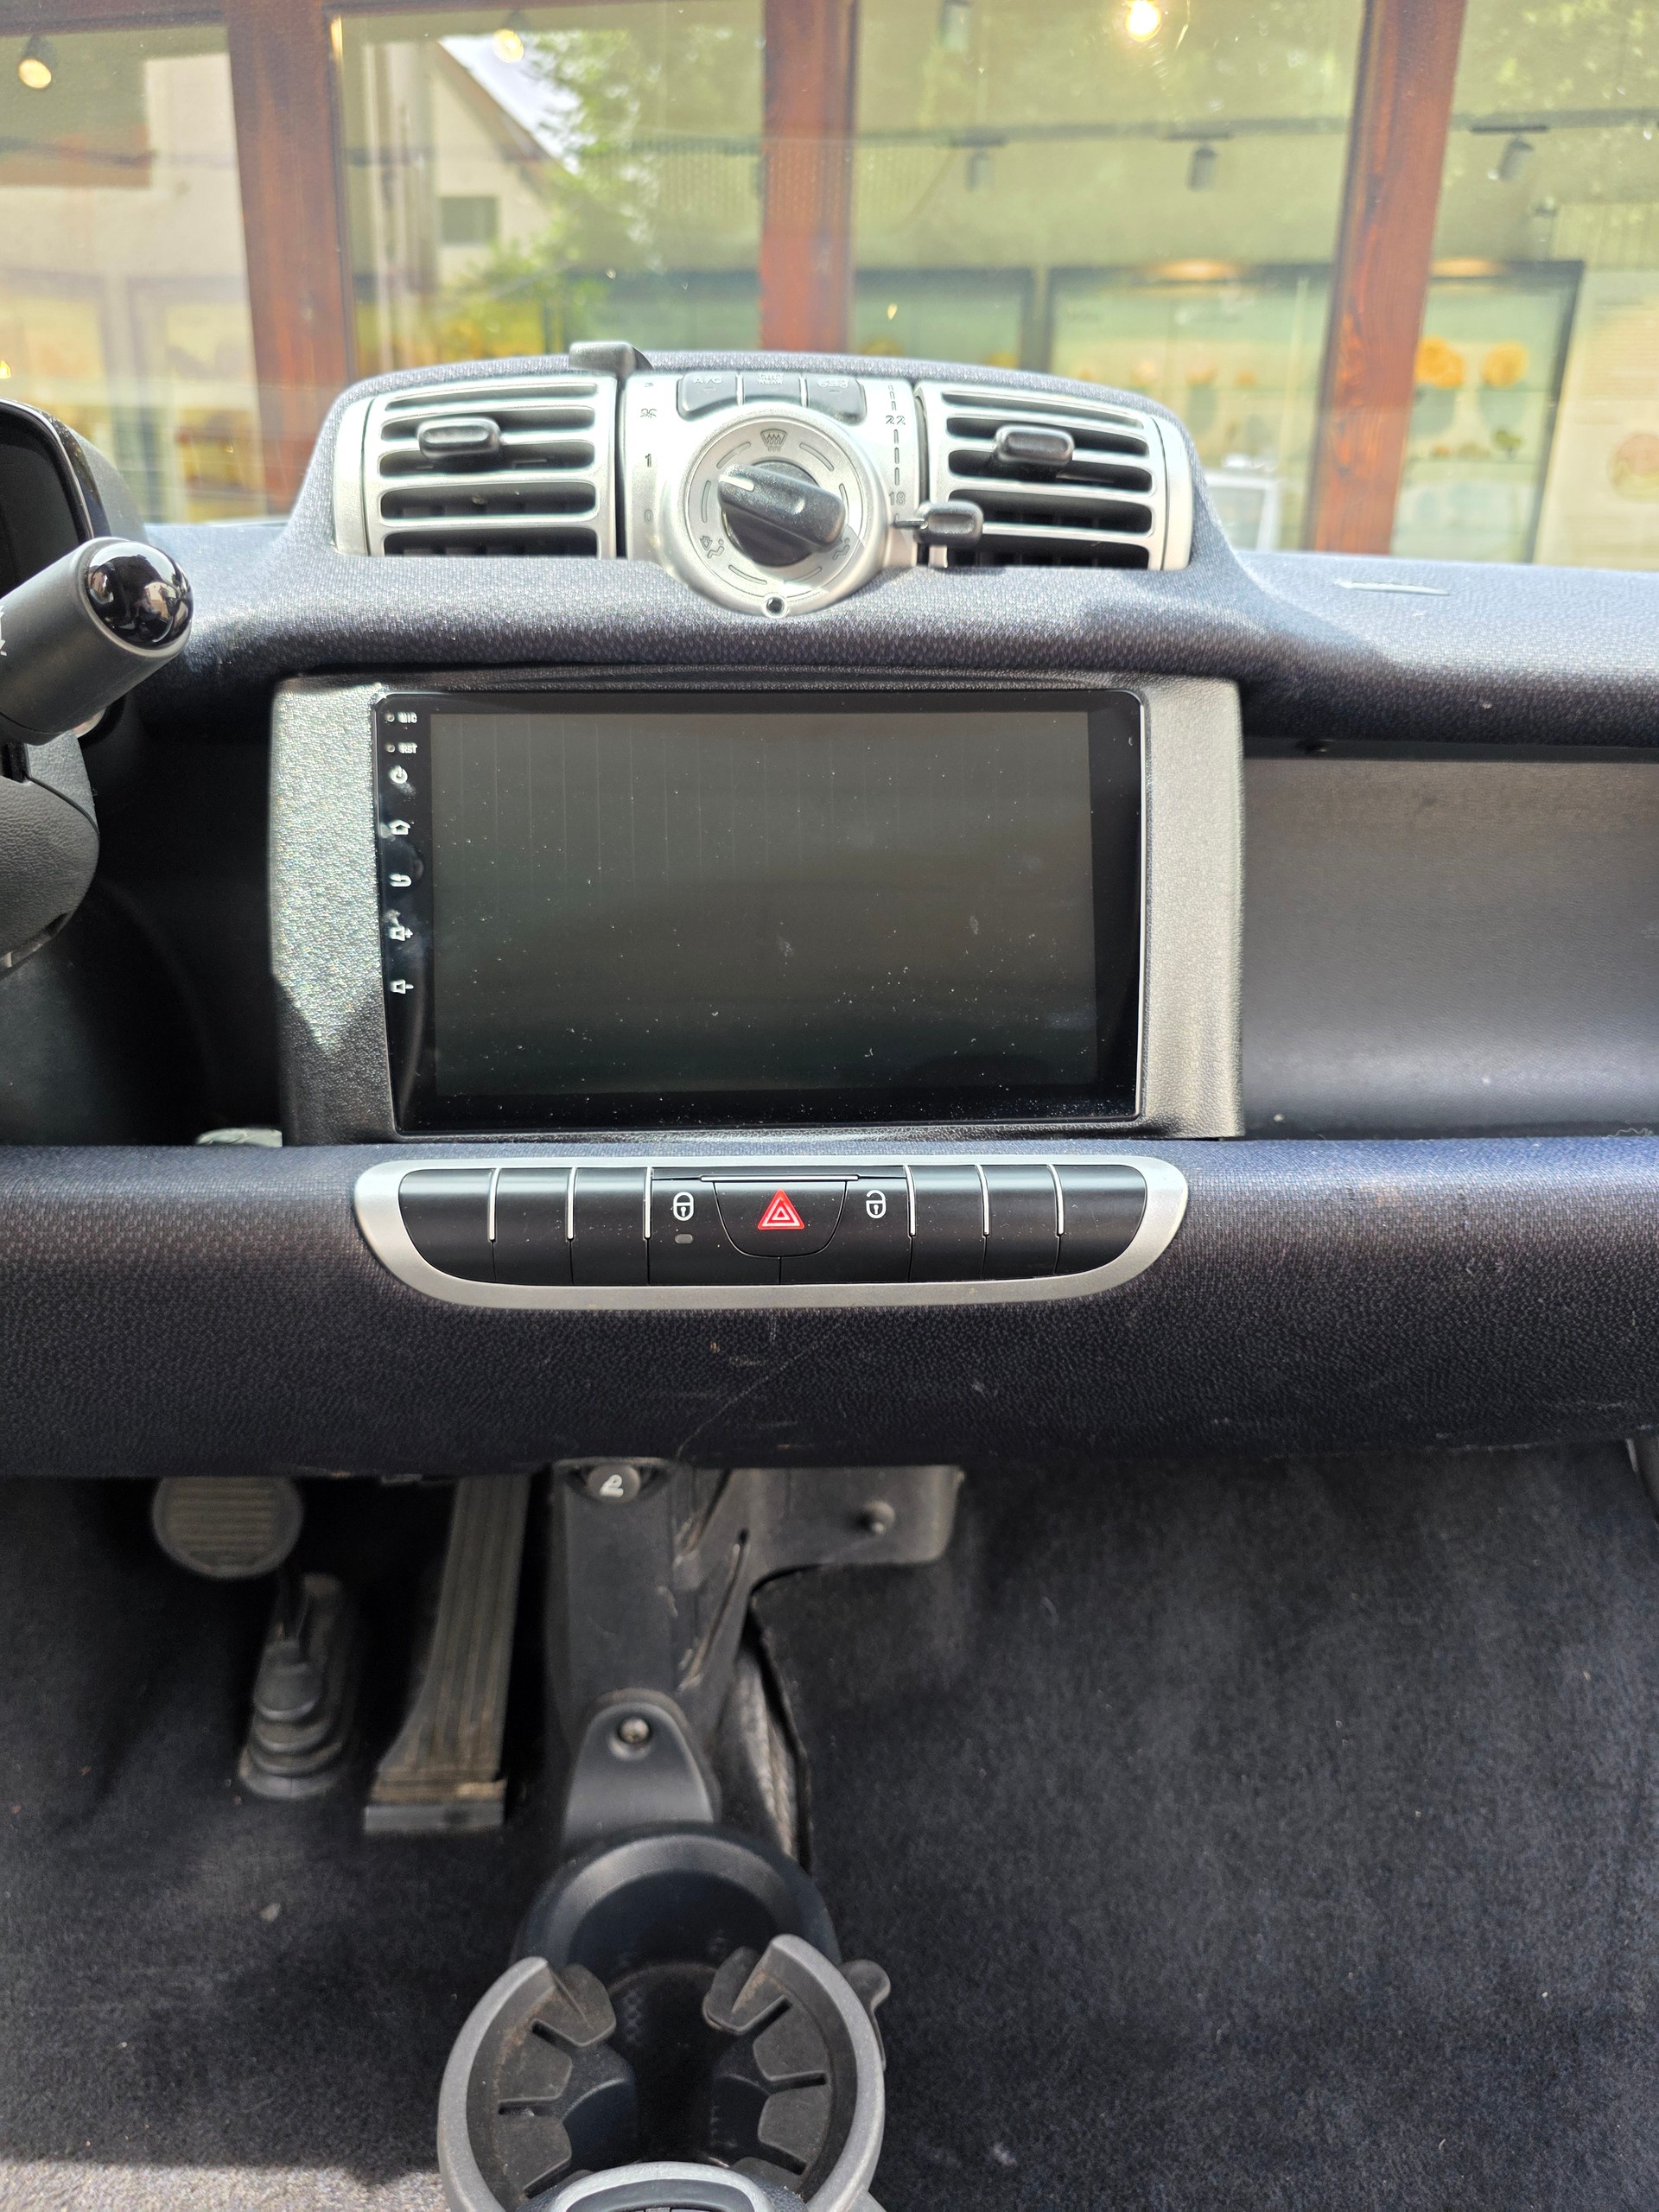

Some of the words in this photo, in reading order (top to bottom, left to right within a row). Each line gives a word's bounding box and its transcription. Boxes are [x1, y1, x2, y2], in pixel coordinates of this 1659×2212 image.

[886, 415, 906, 425] 22
[645, 454, 652, 467] 1
[888, 491, 906, 506] 18
[644, 509, 654, 524] 0
[397, 711, 418, 723] MIC
[397, 742, 418, 754] RST
